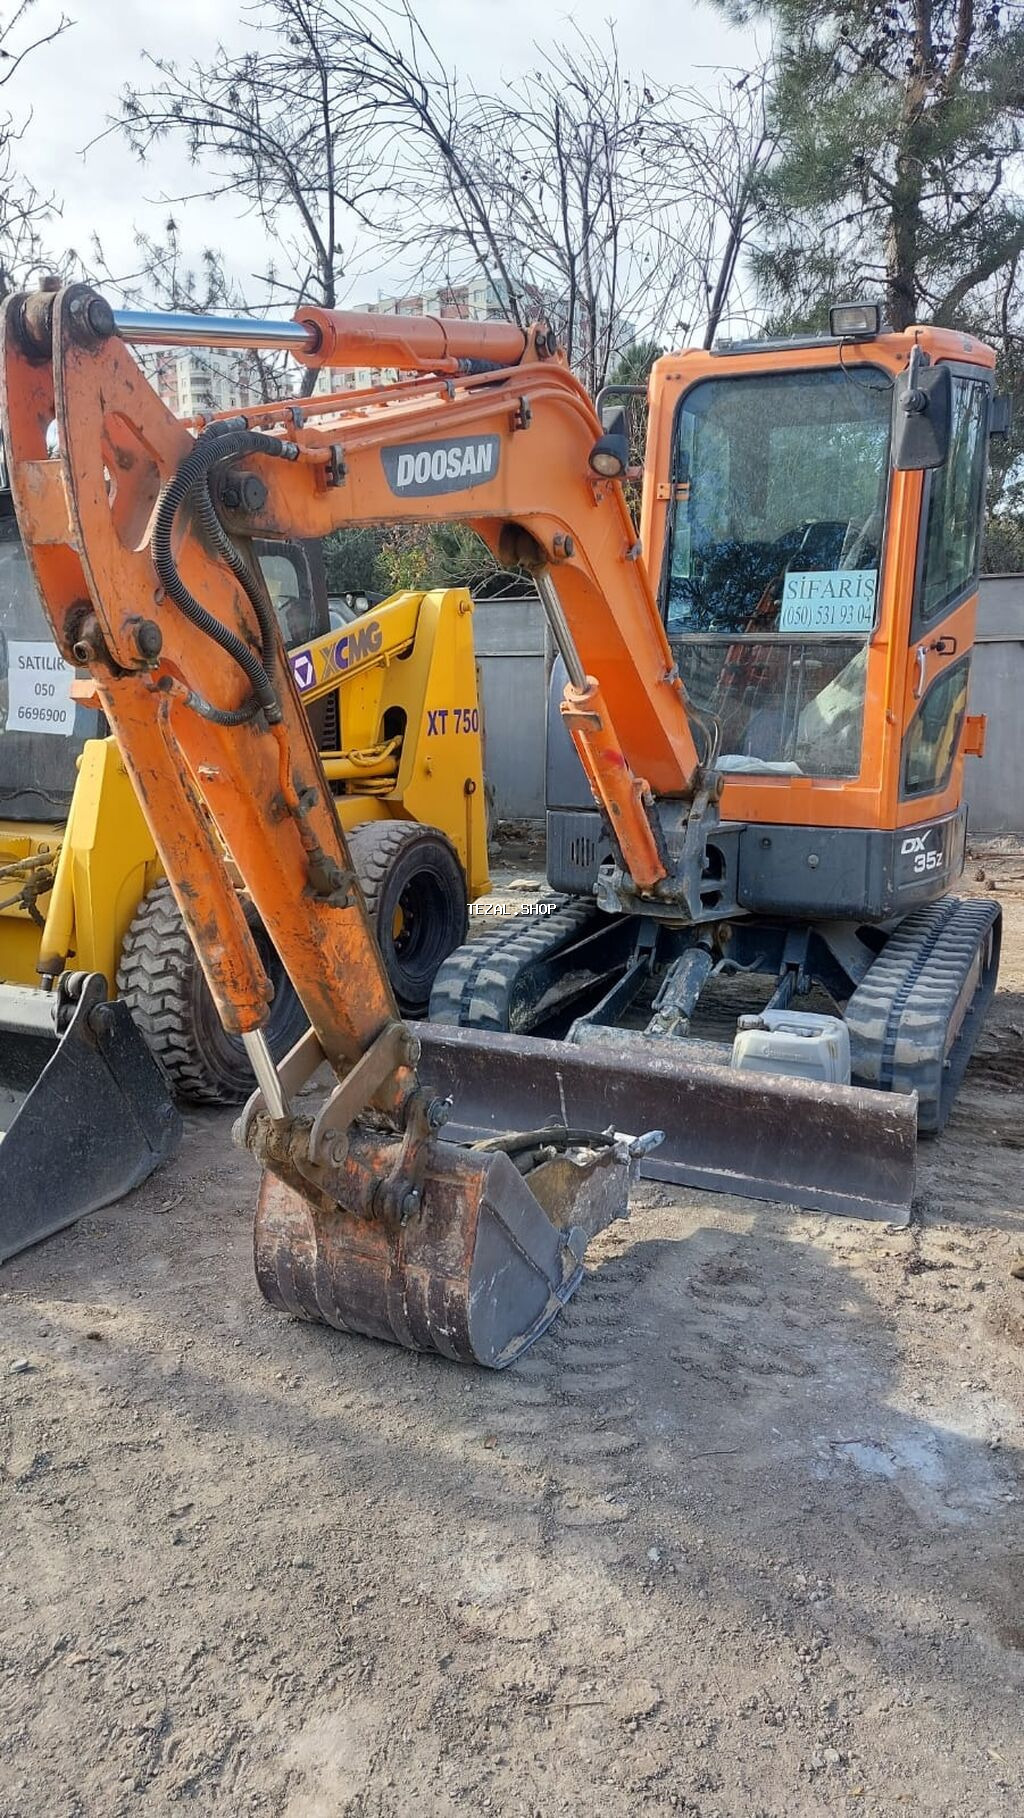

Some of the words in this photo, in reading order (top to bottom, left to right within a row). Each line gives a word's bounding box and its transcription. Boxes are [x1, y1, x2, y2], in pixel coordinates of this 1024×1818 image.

[397, 443, 493, 487] DOOSAN
[786, 574, 875, 602] SİFARİŞ
[782, 604, 812, 626] (050)
[815, 604, 836, 625] 531
[840, 604, 854, 625] 93
[857, 603, 872, 624] 04
[18, 656, 66, 671] SATILIR
[320, 621, 383, 682] XCMG
[34, 682, 56, 697] 050
[17, 706, 67, 722] 6696900
[427, 709, 449, 736] XT
[454, 708, 479, 733] 750
[901, 829, 932, 855] DX
